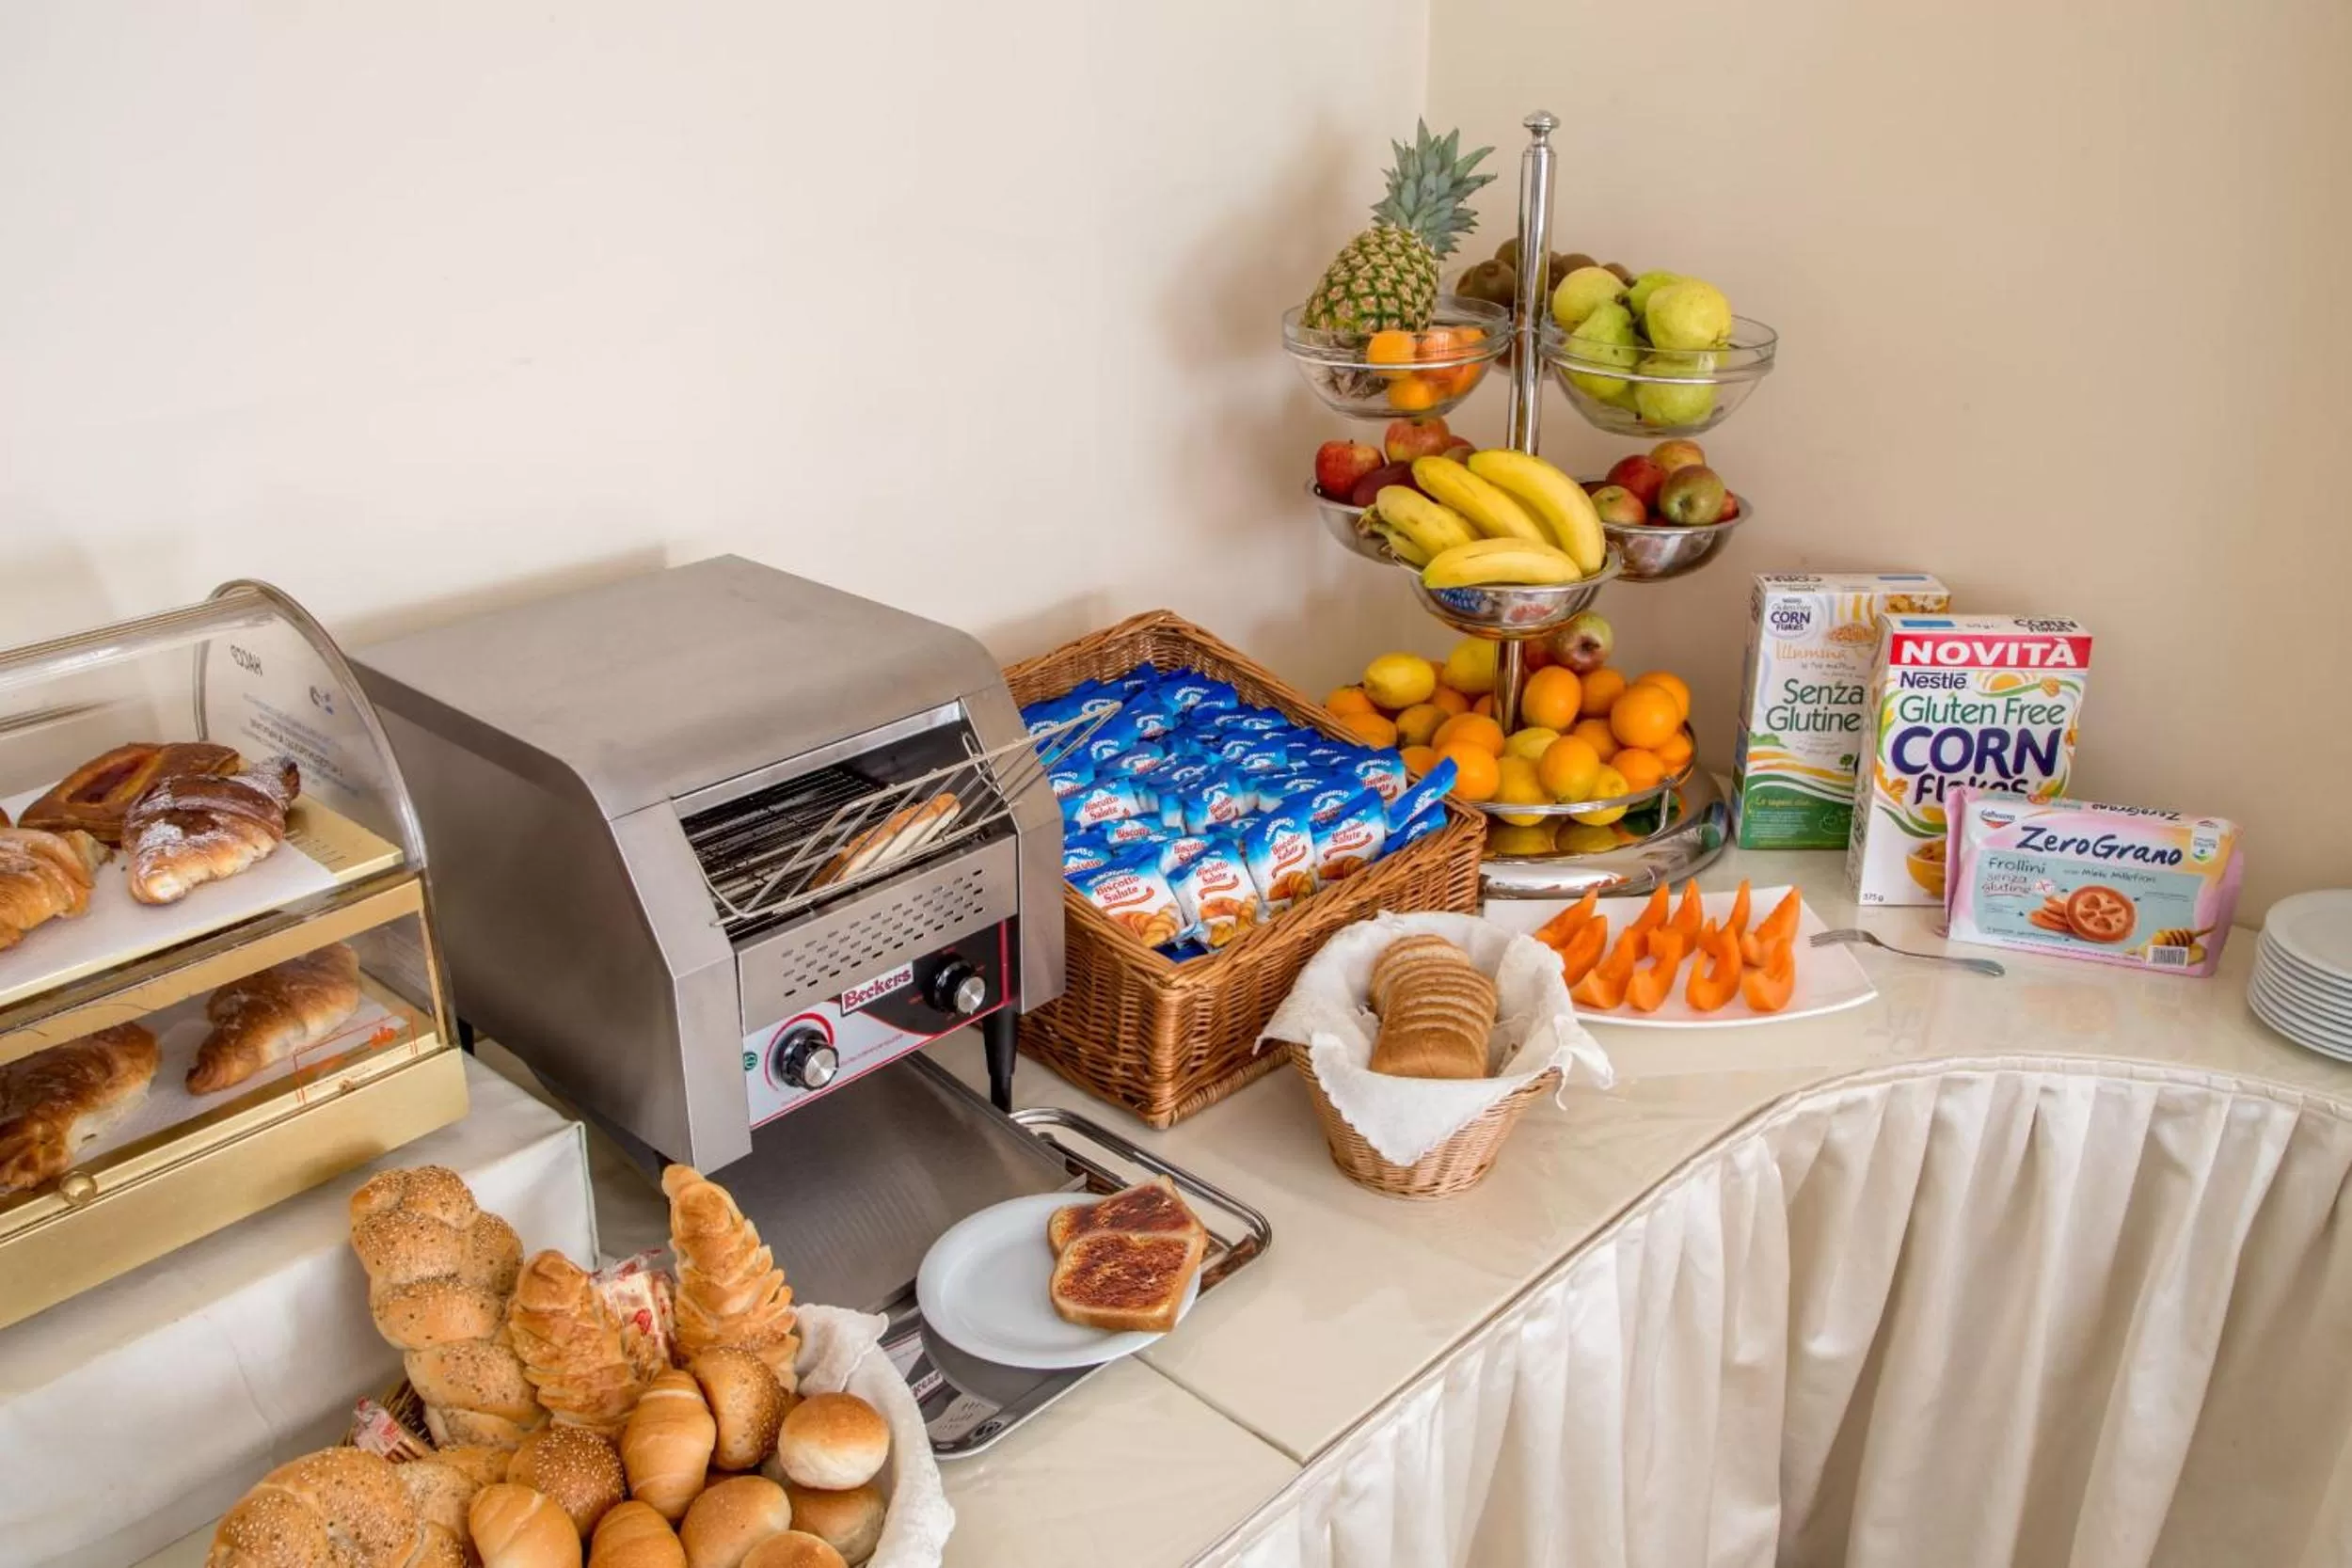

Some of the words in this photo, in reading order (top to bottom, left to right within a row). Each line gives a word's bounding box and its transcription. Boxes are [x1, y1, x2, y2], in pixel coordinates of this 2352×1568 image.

[1771, 611, 1810, 625] CORN
[1900, 637, 2077, 666] NOVITÀ
[1784, 678, 1865, 705] Senza
[1766, 705, 1861, 732] Glutine
[1899, 694, 1997, 725] Gluten
[2004, 697, 2066, 725] Free
[1891, 725, 2062, 780] CORN
[2016, 825, 2184, 866] ZeroGrano
[1989, 857, 2046, 875] Frollini
[1095, 876, 1140, 896] Biscotto
[1104, 886, 1139, 903] Salute
[843, 969, 912, 1010] Beckers
